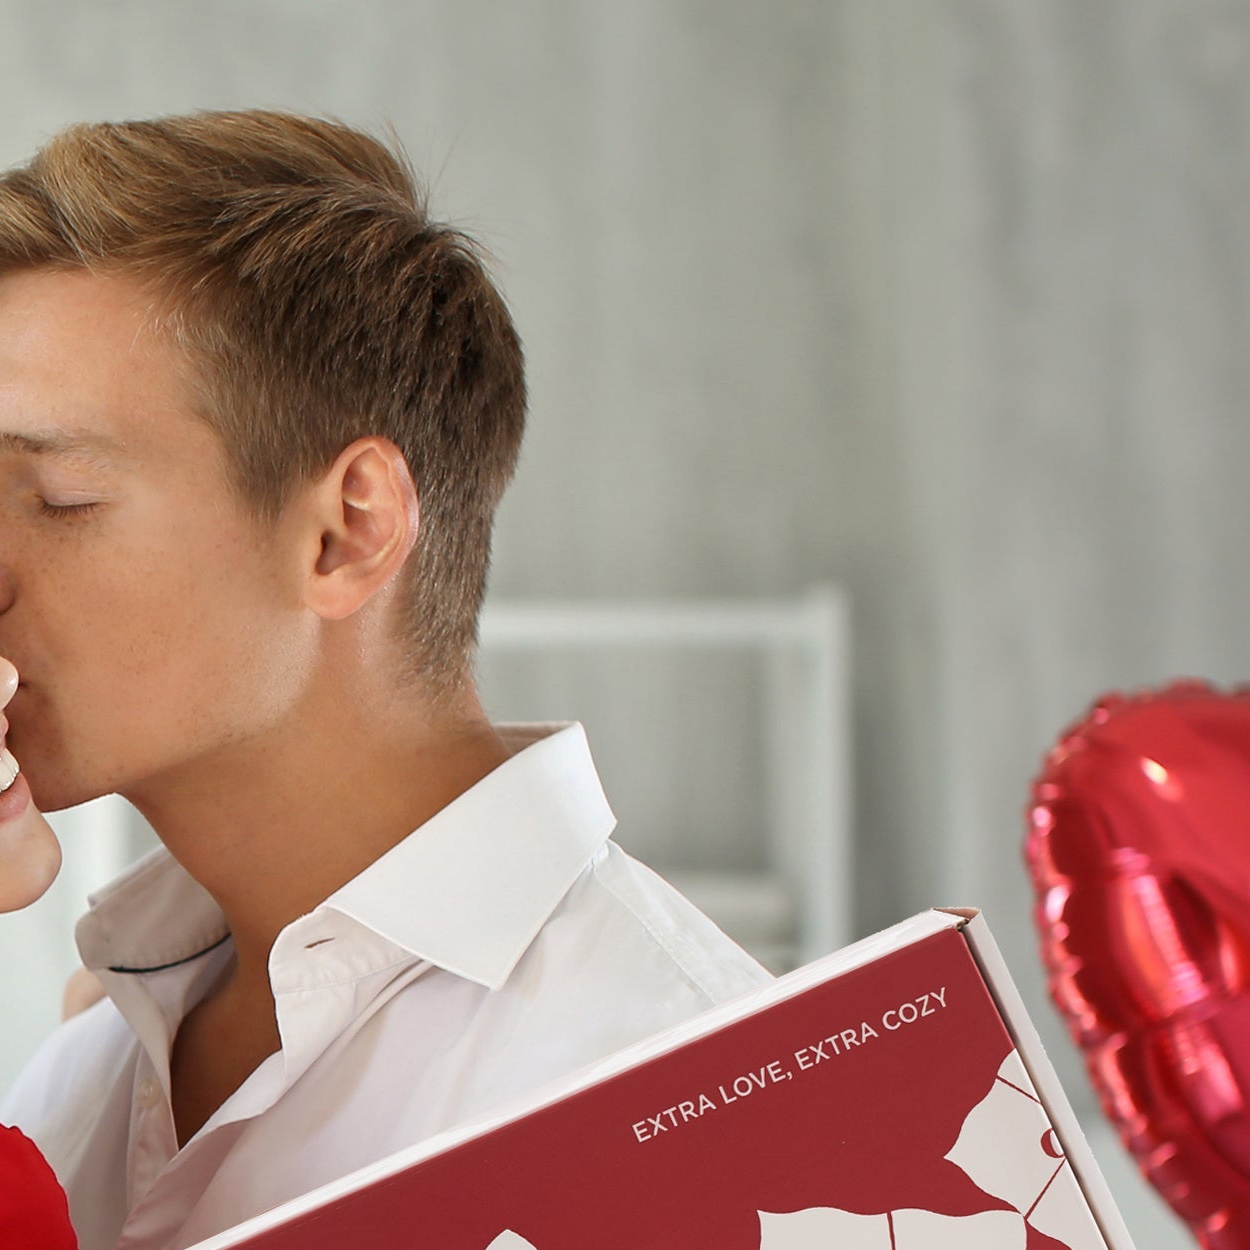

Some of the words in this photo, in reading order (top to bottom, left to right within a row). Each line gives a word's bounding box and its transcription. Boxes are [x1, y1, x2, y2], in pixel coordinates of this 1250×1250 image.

[631, 1094, 717, 1143] EXTRA
[717, 1060, 794, 1106] LOVE,
[794, 1021, 880, 1071] EXTRA
[881, 986, 948, 1031] COZY
